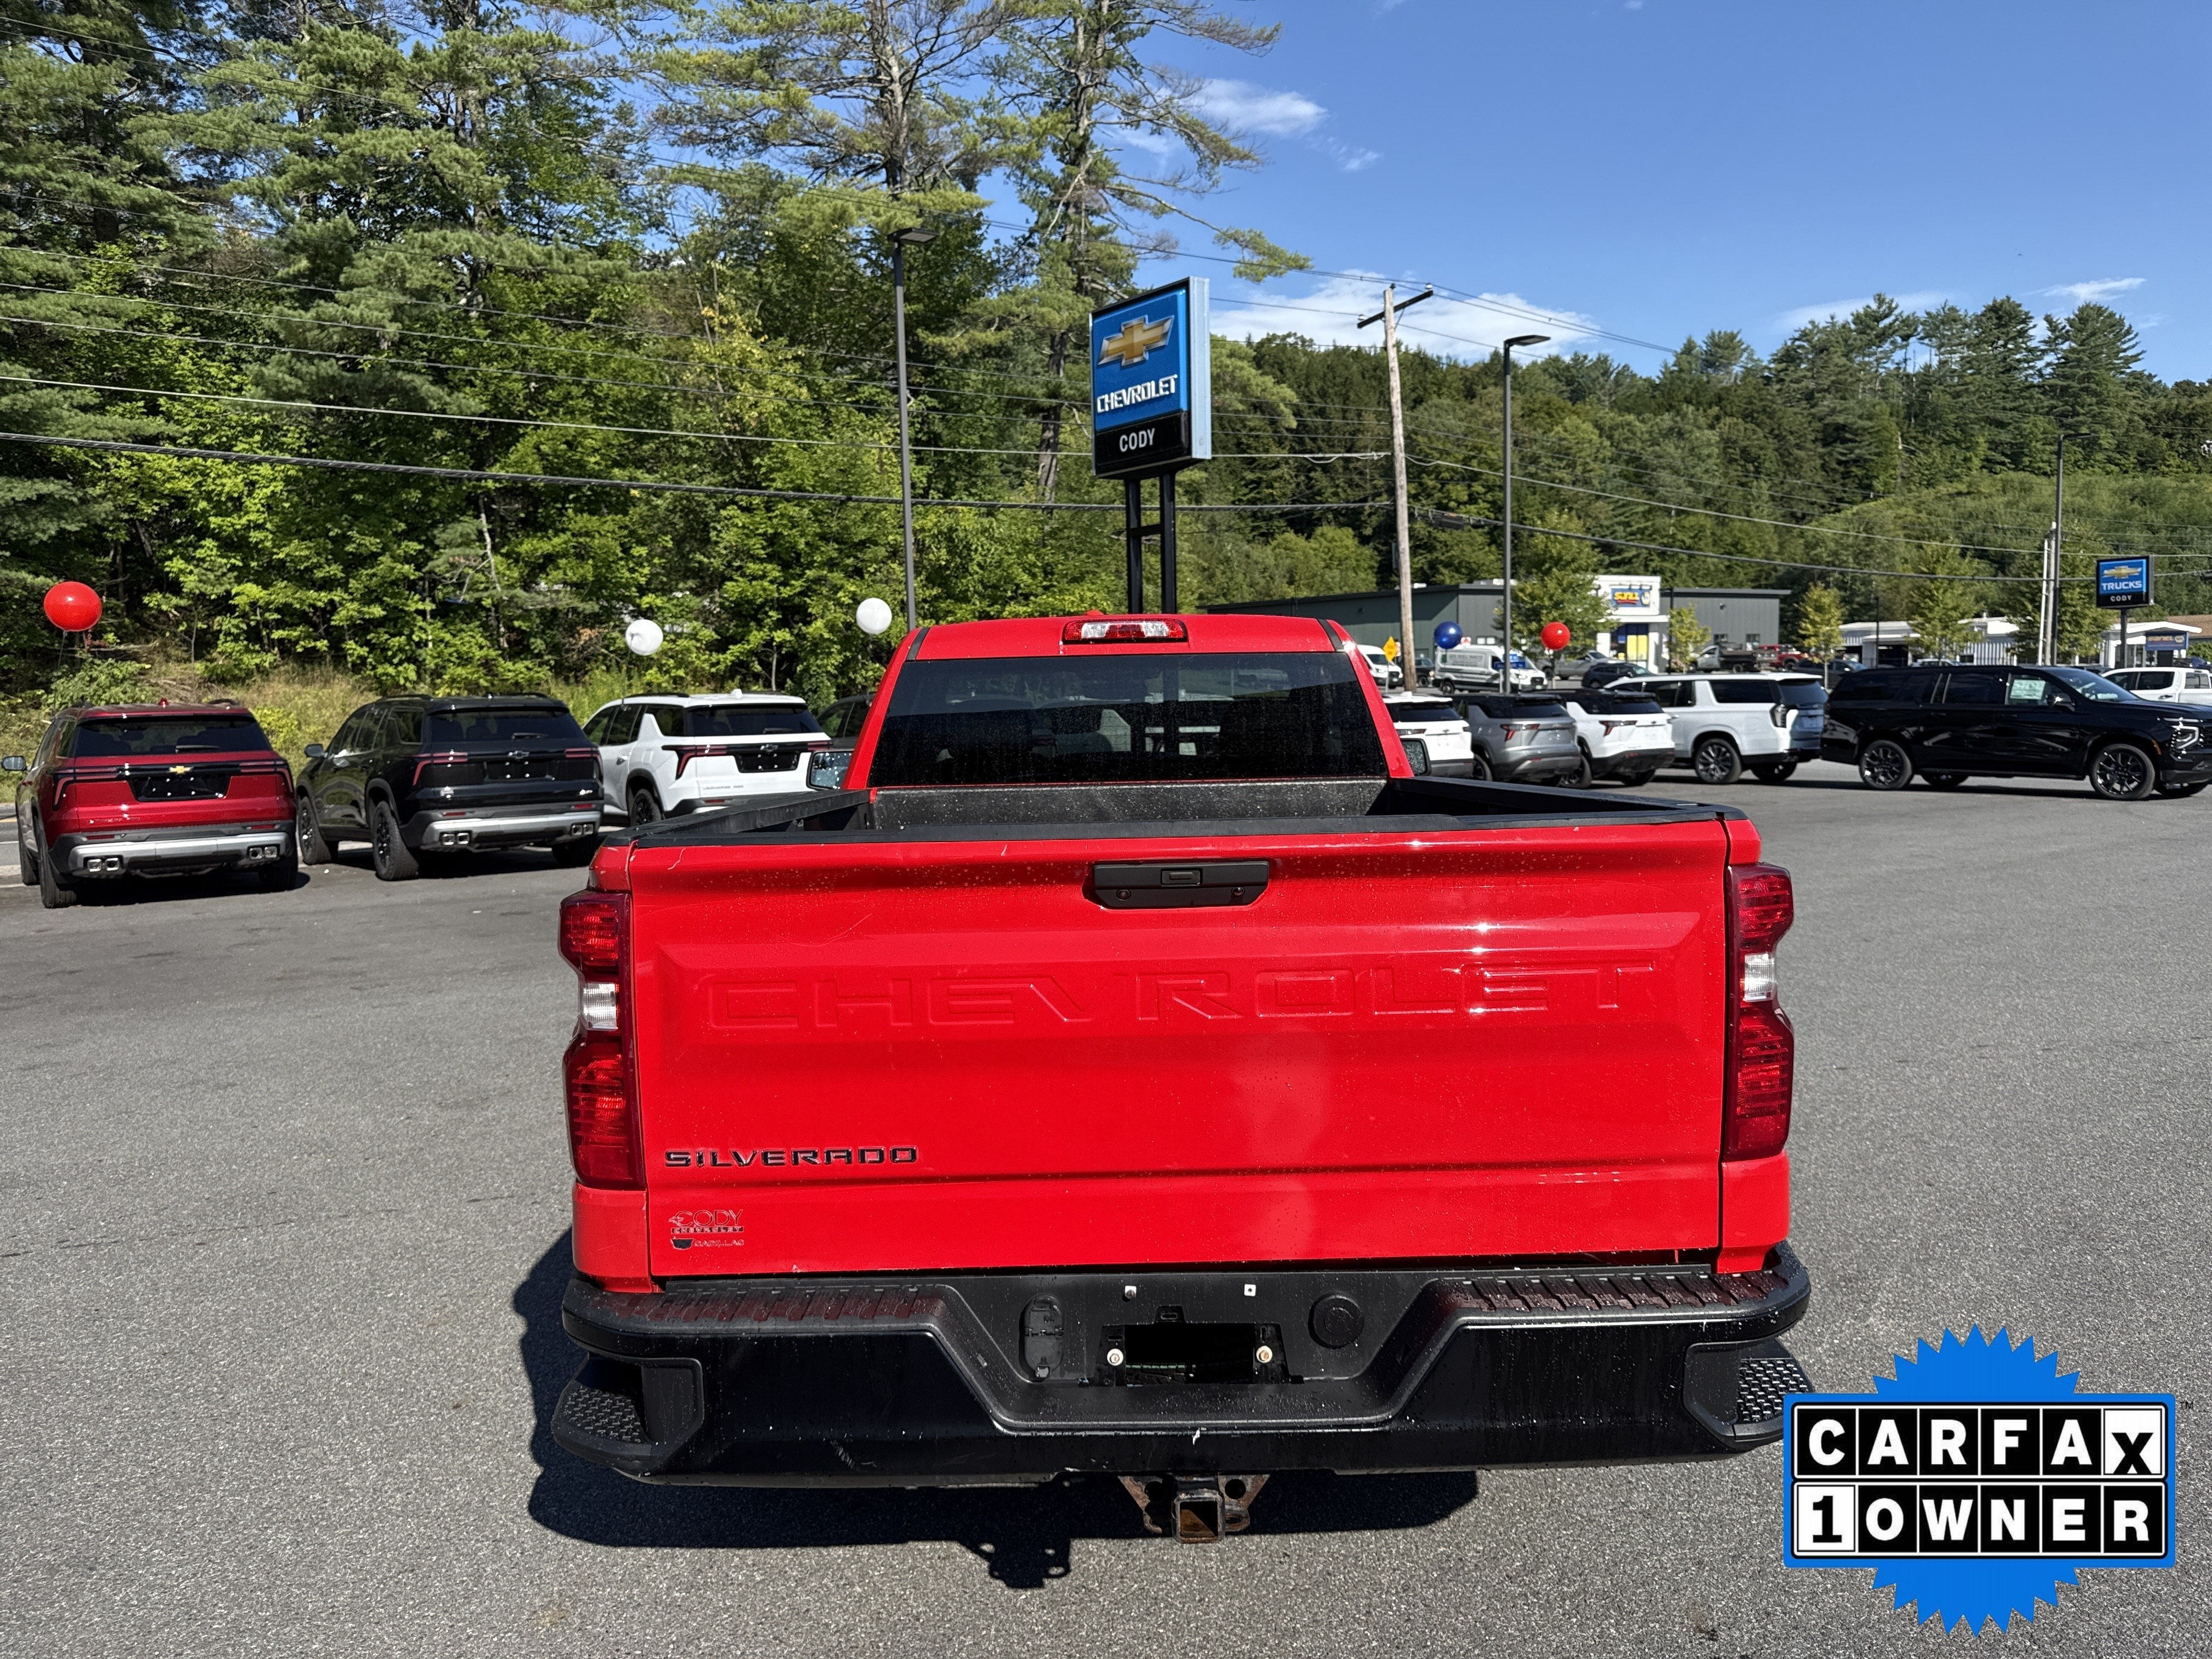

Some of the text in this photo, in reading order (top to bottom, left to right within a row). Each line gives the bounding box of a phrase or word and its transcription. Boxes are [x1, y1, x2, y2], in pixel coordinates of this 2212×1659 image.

[1097, 374, 1178, 413] CHEVROLET
[1119, 428, 1155, 452] CODY
[2102, 580, 2142, 591] TRUCKS
[709, 961, 1654, 1028] CHEVROLET
[665, 1146, 918, 1167] SILVERADO
[674, 1209, 743, 1226] CODY
